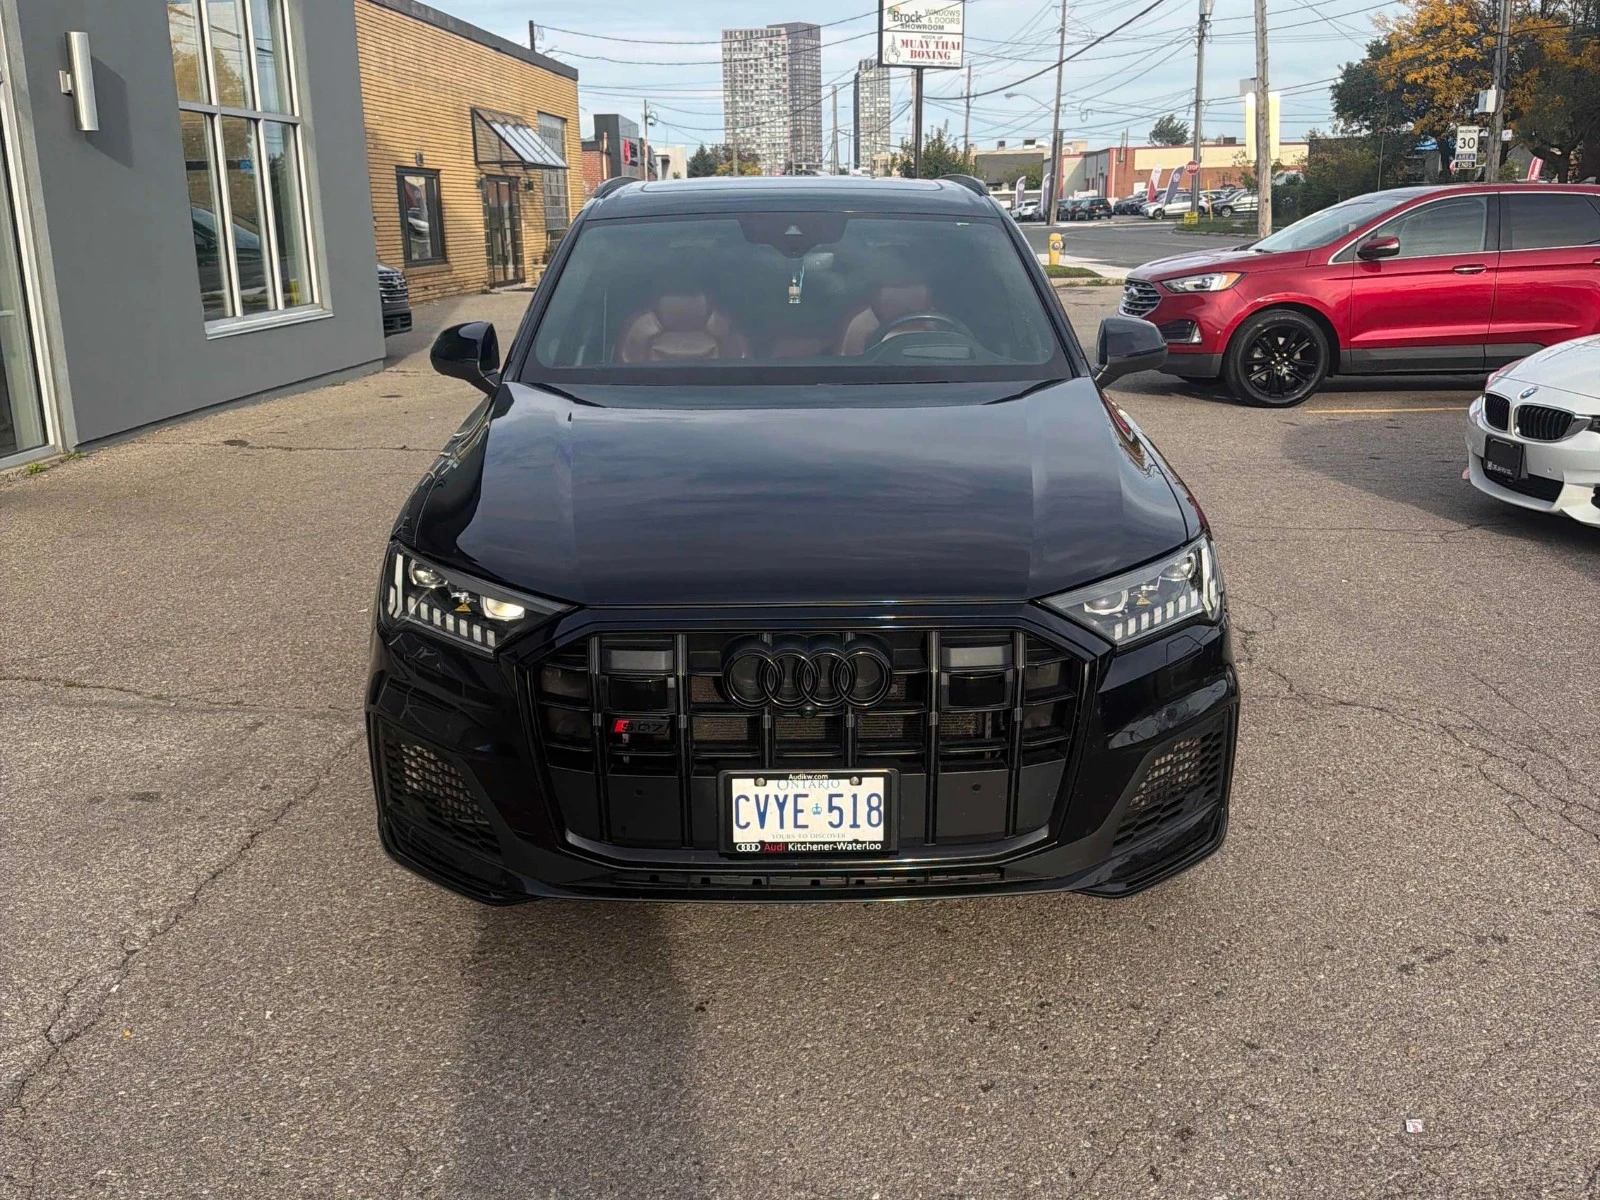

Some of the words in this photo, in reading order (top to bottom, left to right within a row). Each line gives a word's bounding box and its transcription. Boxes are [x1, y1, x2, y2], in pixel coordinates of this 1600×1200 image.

[893, 11, 922, 23] Brock
[900, 23, 944, 31] SHOWROOM
[900, 39, 932, 49] MUAY
[934, 41, 960, 50] THAI
[910, 50, 951, 60] BOXING
[1458, 137, 1476, 149] 30
[777, 780, 840, 790] ONTARIO
[735, 794, 809, 829] CVYE
[827, 793, 883, 829] 518
[763, 843, 786, 852] Audi
[788, 842, 882, 852] Kitchener-Waterloo
